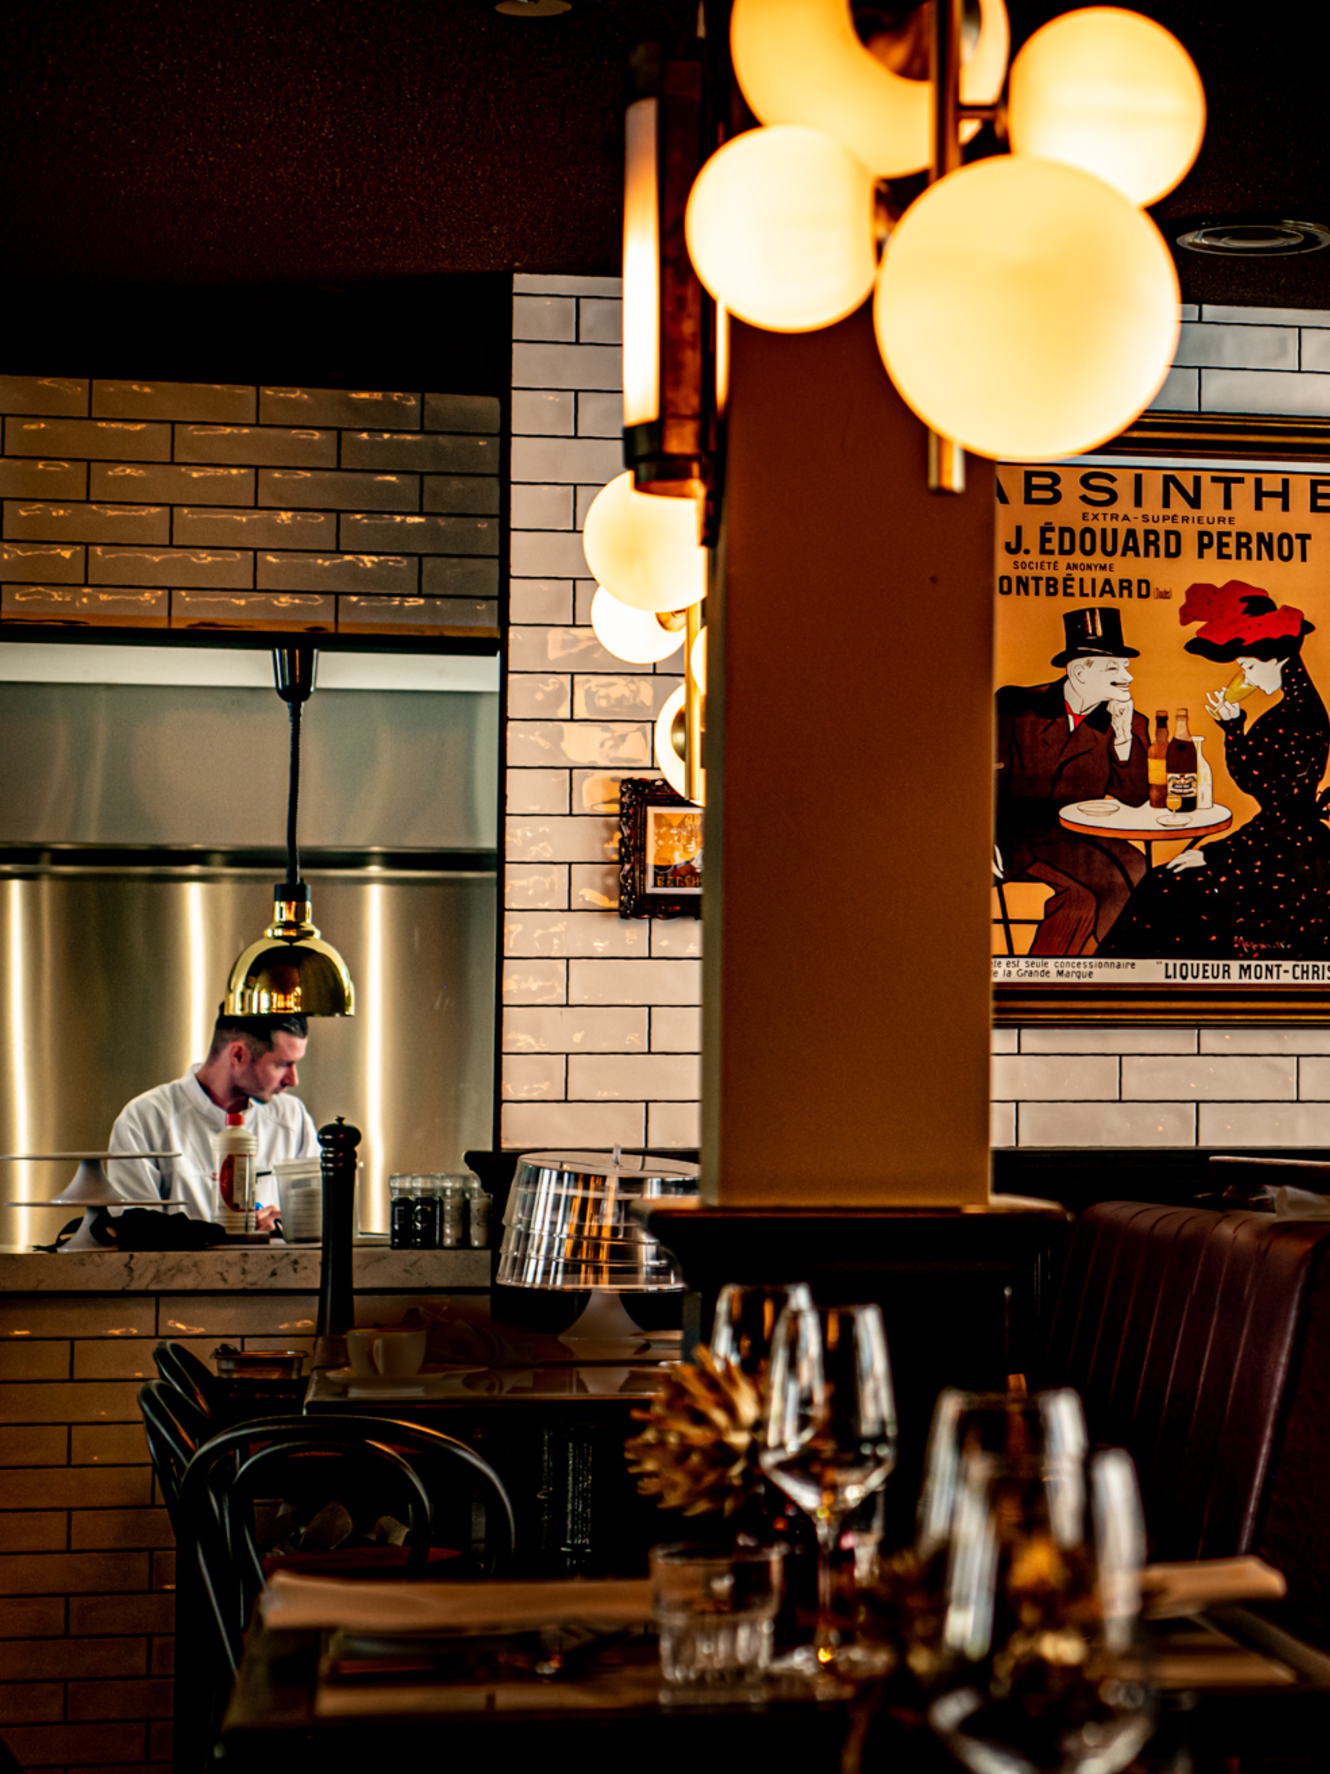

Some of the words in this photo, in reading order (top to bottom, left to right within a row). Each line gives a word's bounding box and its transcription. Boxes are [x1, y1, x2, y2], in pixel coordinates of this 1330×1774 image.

[1005, 525, 1031, 555] J.
[1039, 522, 1183, 559] ÉDOUARD
[1197, 530, 1312, 563] PERNOT
[1065, 562, 1115, 573] ANONYME
[1005, 960, 1020, 969] est
[1025, 958, 1049, 969] seule
[1054, 960, 1136, 970] concessionnaire
[1003, 969, 1012, 978] la
[1016, 969, 1051, 978] Grande
[1055, 969, 1094, 981] Marque
